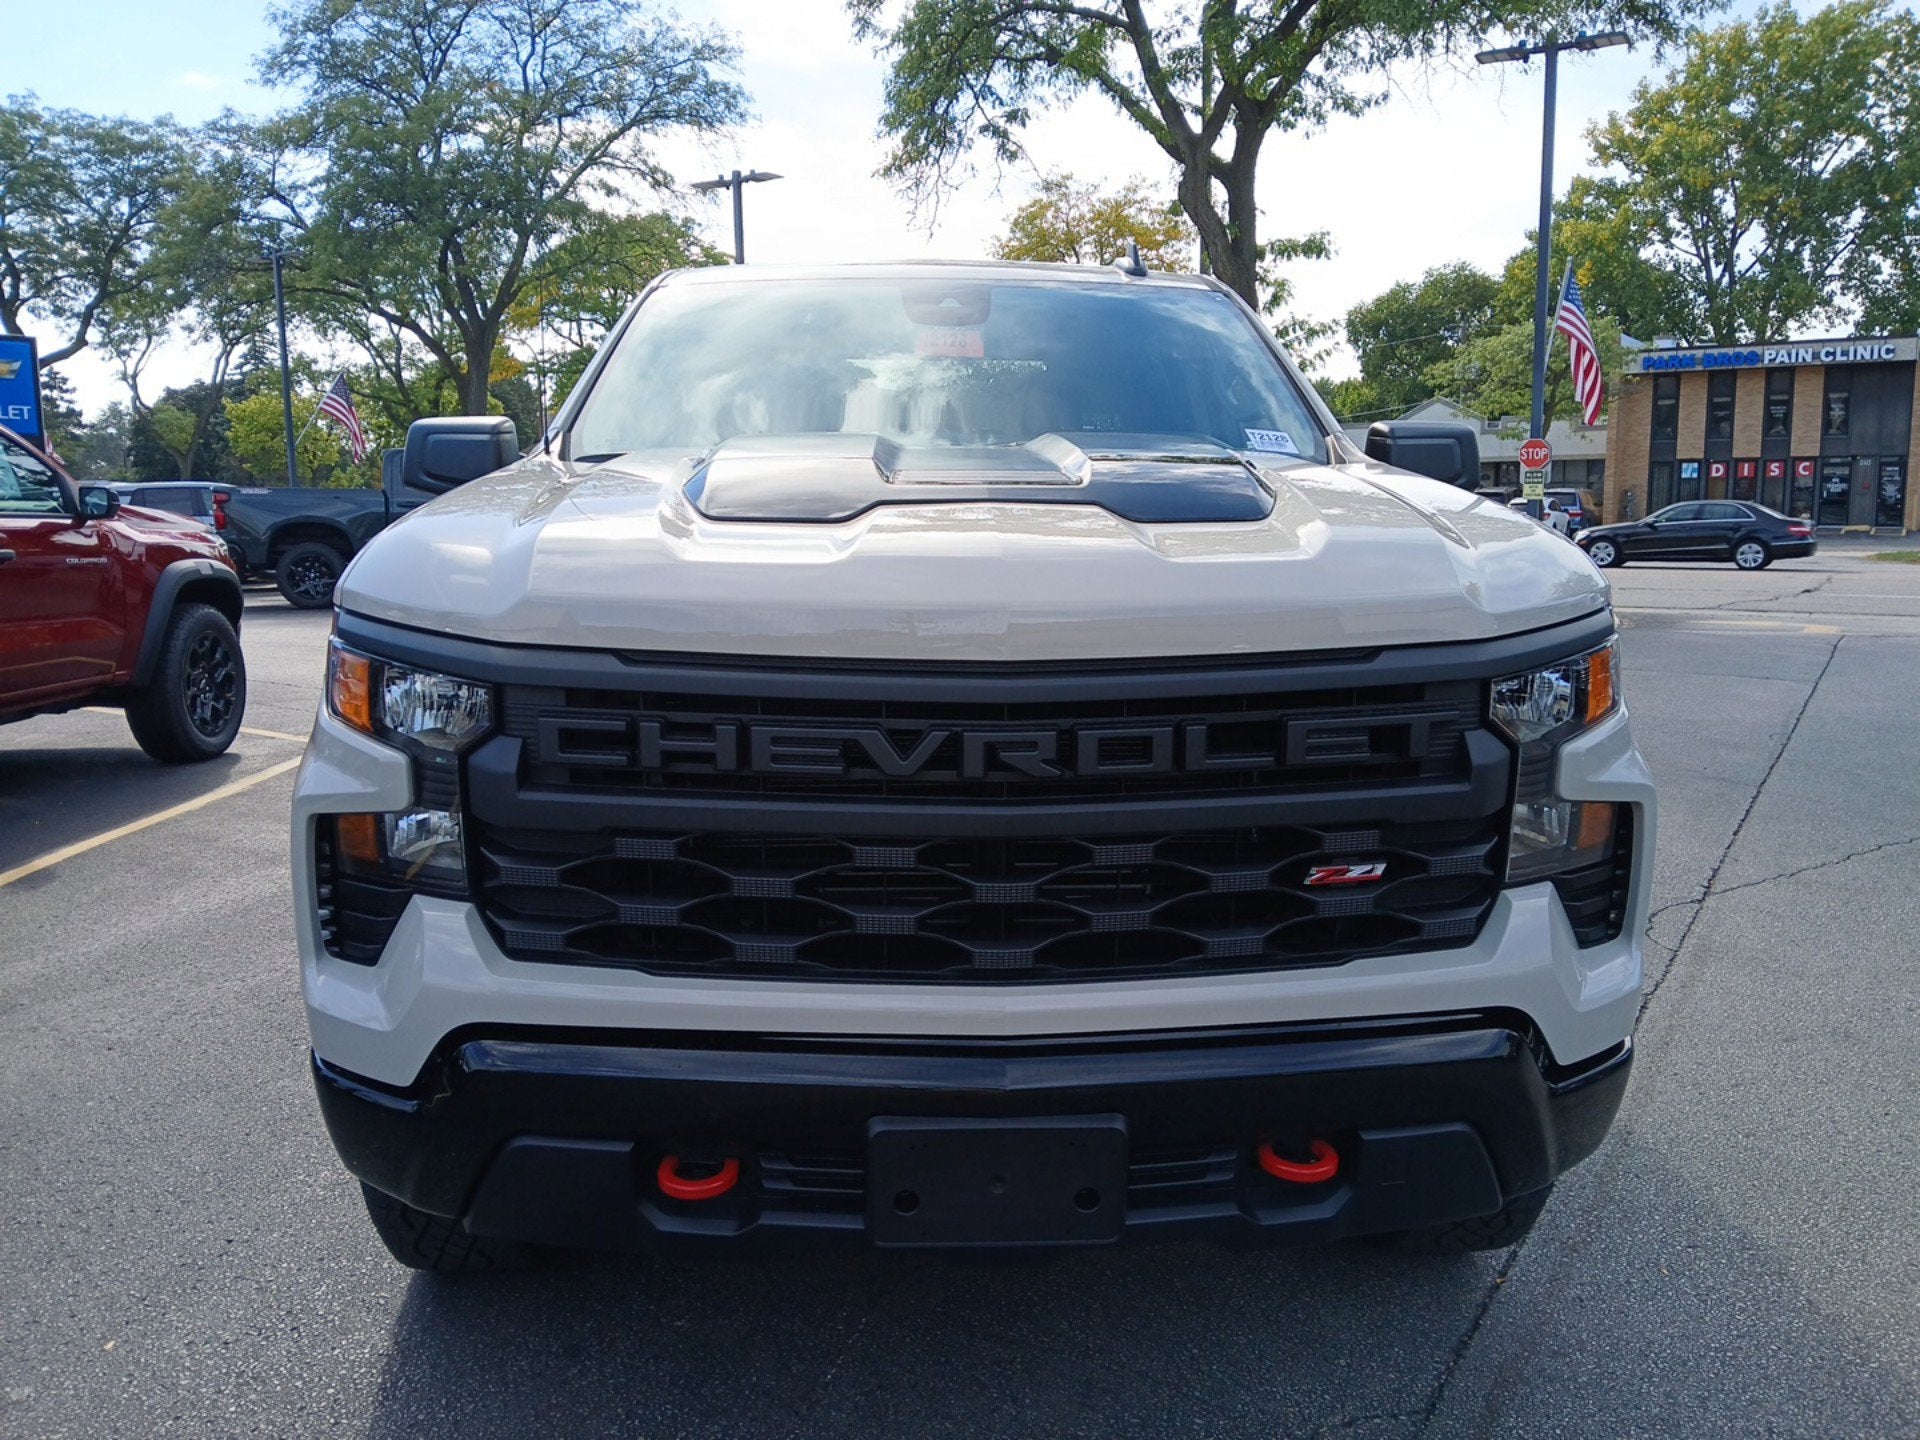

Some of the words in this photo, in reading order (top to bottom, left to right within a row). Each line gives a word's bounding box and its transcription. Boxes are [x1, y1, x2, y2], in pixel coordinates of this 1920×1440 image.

[1642, 352, 1697, 370] PARK
[1702, 350, 1760, 368] BROS
[1763, 347, 1813, 365] PAIN
[1819, 343, 1896, 362] CLINIC
[1520, 447, 1548, 460] STOP
[65, 557, 108, 565] COLORADO
[537, 710, 1460, 778] CHEVROLET
[1303, 863, 1388, 885] Z71
